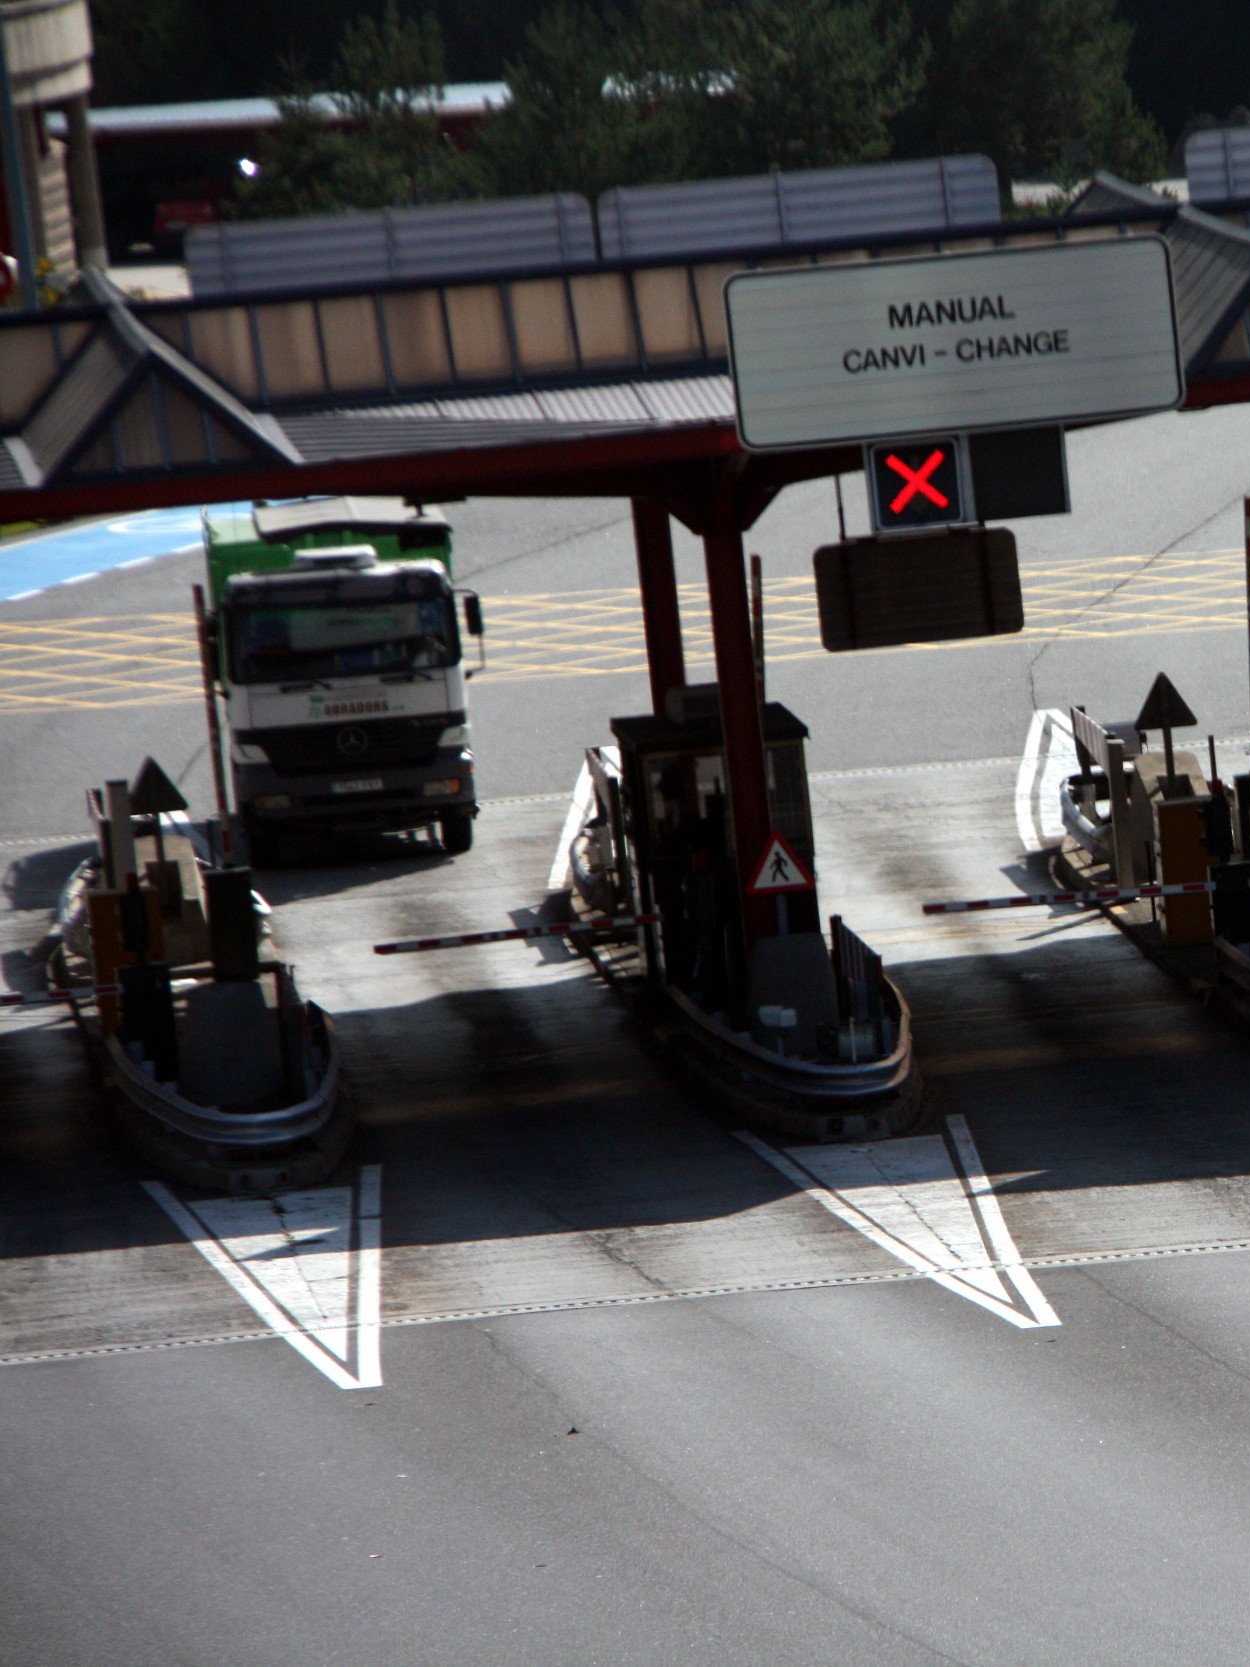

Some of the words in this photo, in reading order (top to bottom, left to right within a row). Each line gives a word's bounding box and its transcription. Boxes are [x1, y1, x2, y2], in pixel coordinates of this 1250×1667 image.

[888, 295, 1015, 329] MANUAL
[842, 344, 926, 374] CANVI
[955, 329, 1069, 363] CHANGE
